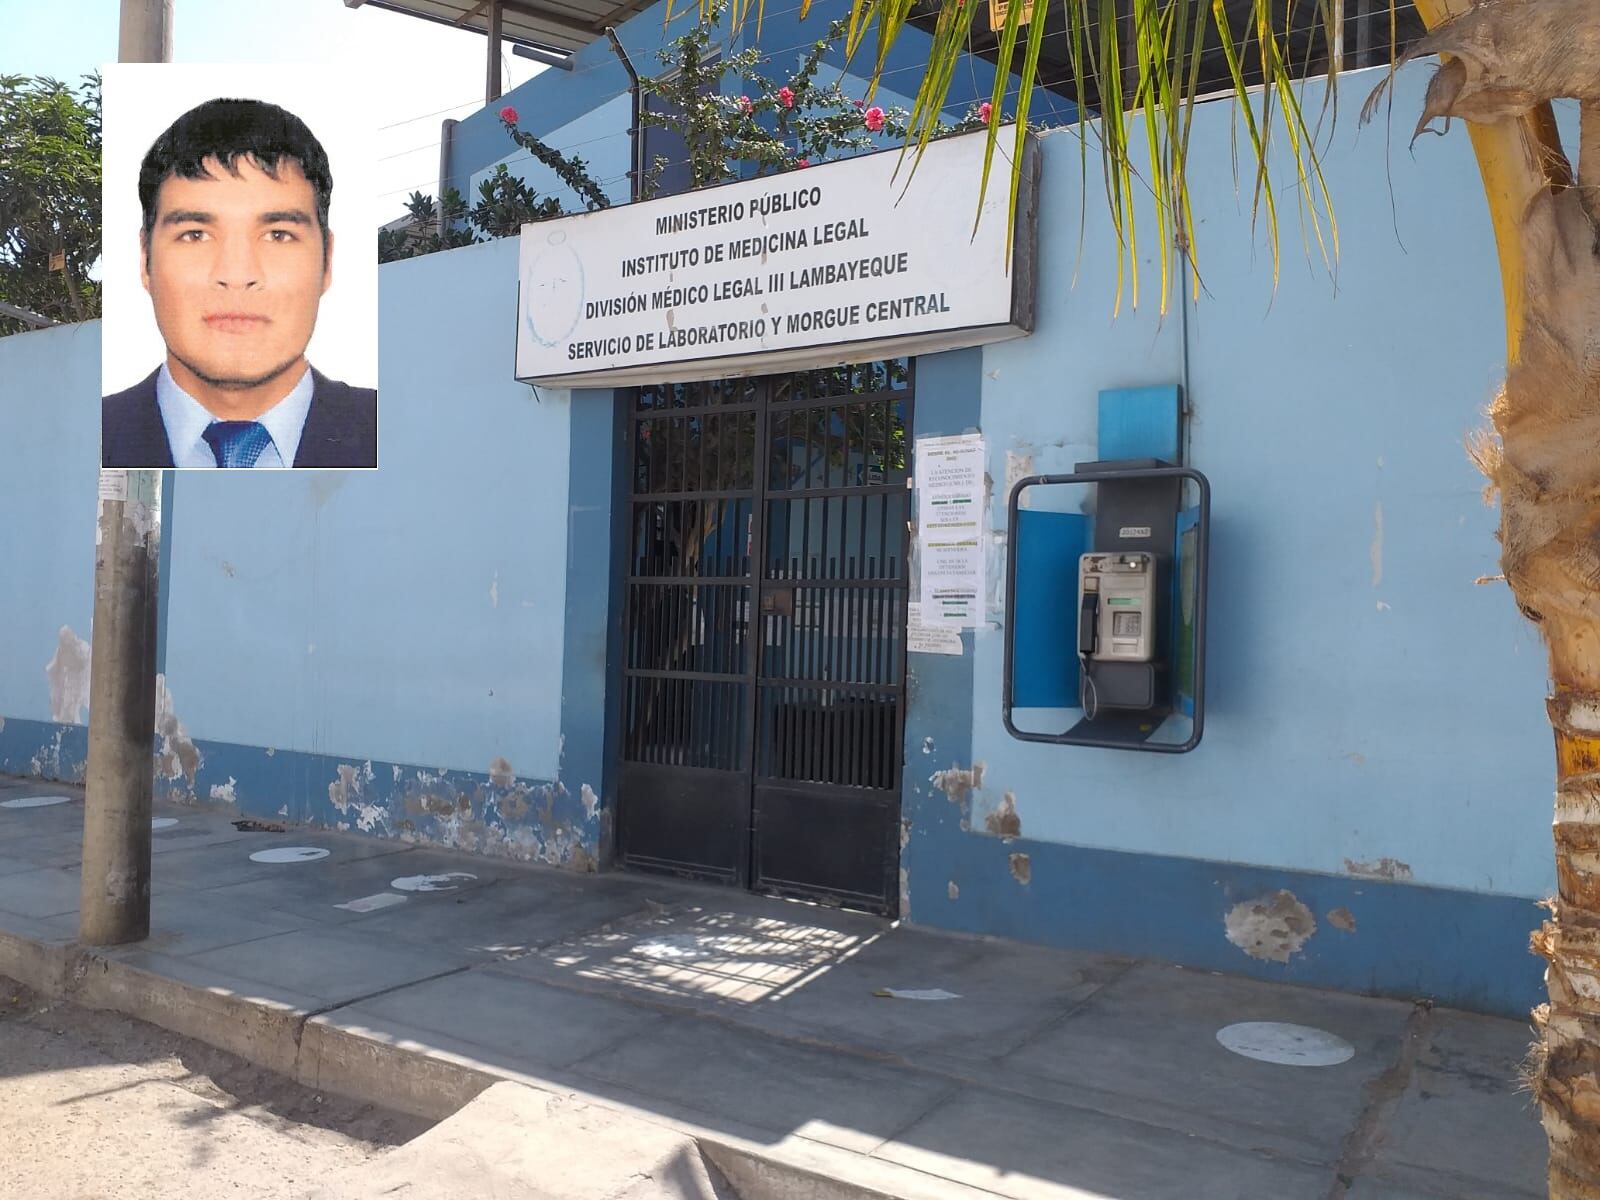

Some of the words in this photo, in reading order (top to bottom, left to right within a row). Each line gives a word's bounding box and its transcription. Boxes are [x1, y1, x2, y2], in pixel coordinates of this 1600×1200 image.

[655, 202, 744, 236] MINISTERIO
[749, 186, 822, 218] PÚBLICO
[621, 248, 699, 278] INSTITUTO
[704, 243, 724, 264] DE
[728, 228, 808, 261] MEDICINA
[813, 217, 869, 246] LEGAL
[585, 291, 647, 320] DIVISIÓN
[651, 284, 709, 310] MÉDICO
[713, 276, 763, 302] LEGAL
[768, 273, 784, 293] III
[790, 252, 908, 290] LAMBAYEQUE
[568, 335, 631, 361] SERVICIO
[636, 333, 655, 352] DE
[659, 318, 766, 350] LABORATORIO
[770, 315, 782, 336] Y
[786, 305, 860, 334] MORGUE
[865, 292, 951, 323] CENTRAL
